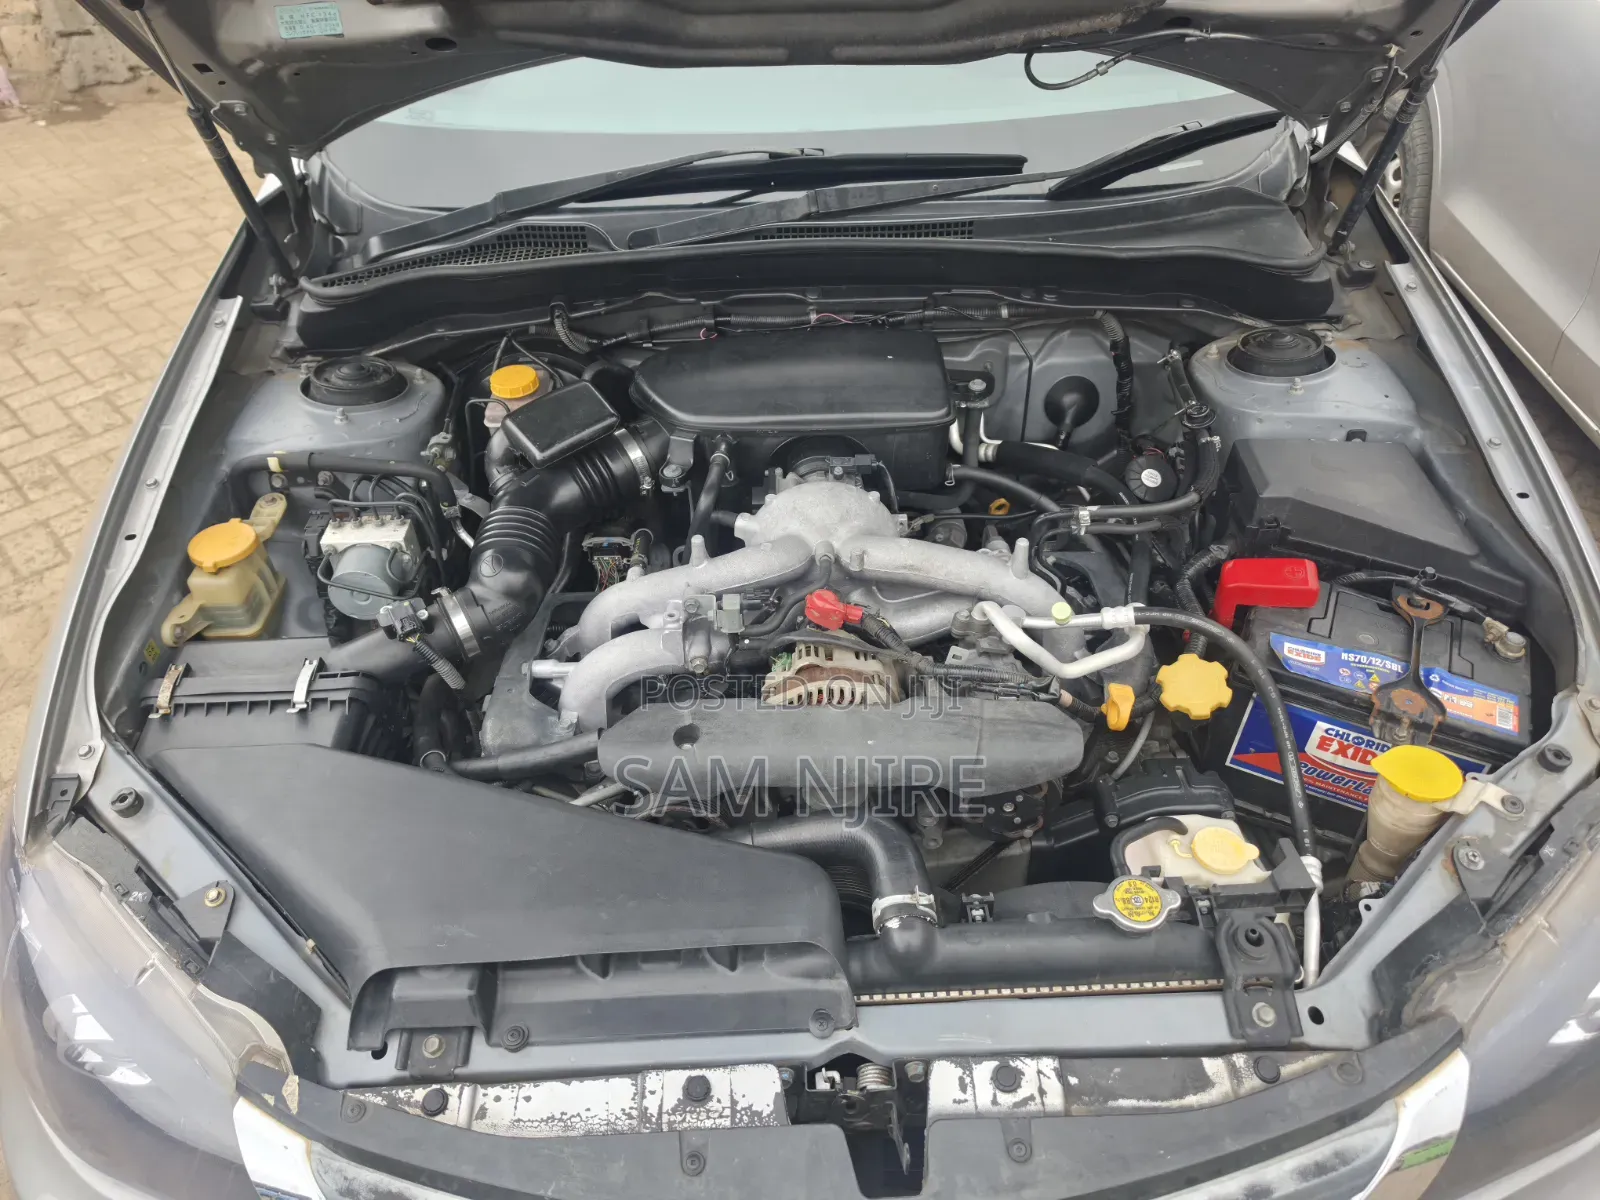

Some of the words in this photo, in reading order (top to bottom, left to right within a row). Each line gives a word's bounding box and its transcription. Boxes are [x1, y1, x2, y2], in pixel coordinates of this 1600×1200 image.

[1287, 650, 1322, 662] EXIDE
[1316, 735, 1379, 766] EXID
[1324, 727, 1391, 753] CHLORID
[1315, 782, 1363, 800] MAINTENANCE
